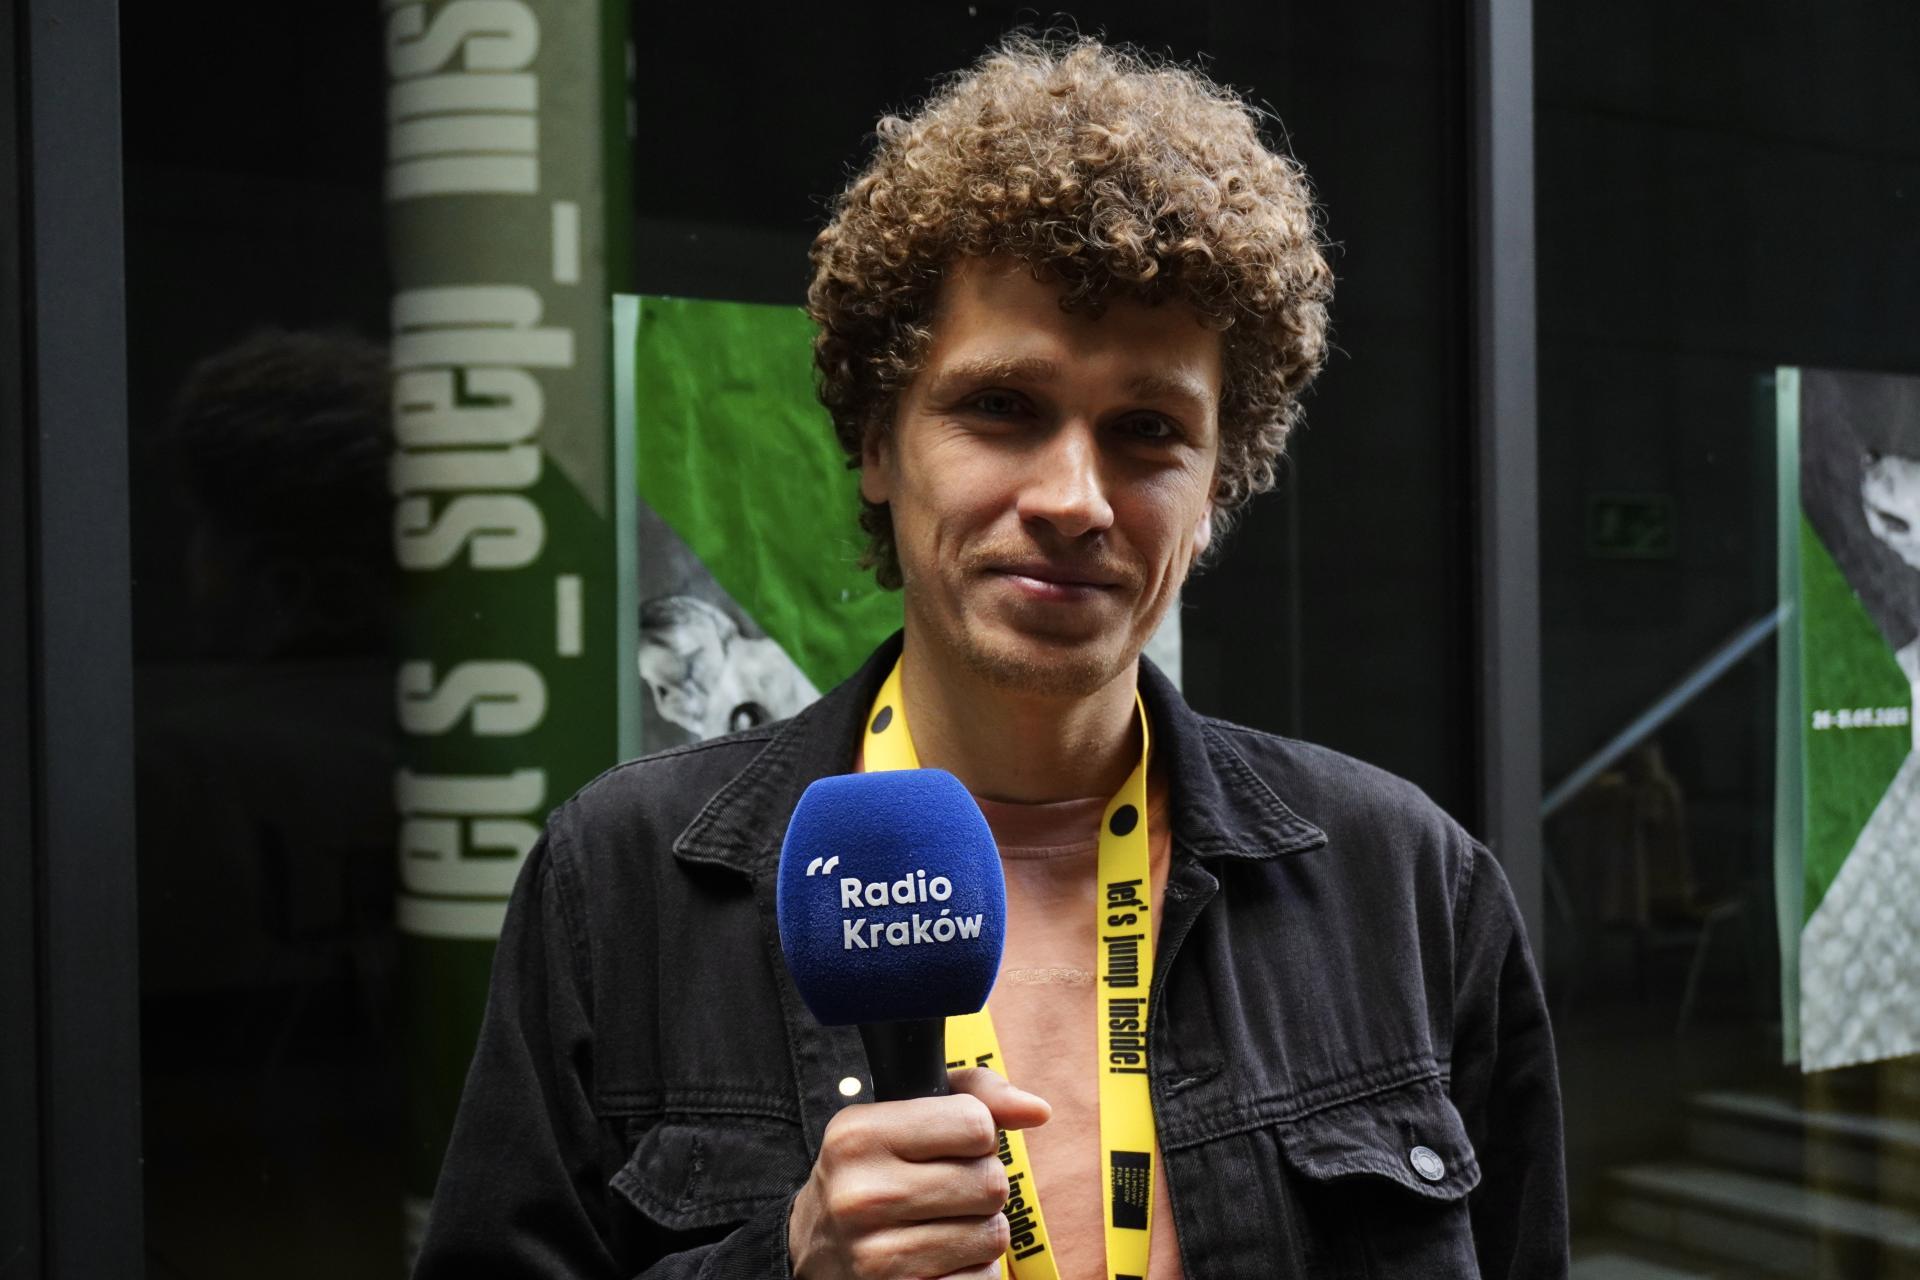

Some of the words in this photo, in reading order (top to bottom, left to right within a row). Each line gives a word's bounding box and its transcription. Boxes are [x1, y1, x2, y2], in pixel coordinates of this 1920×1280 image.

[840, 869, 952, 908] Radio
[1107, 879, 1149, 927] let's
[843, 908, 983, 950] Kraków
[1103, 934, 1145, 988] jump
[1109, 998, 1147, 1075] inside!
